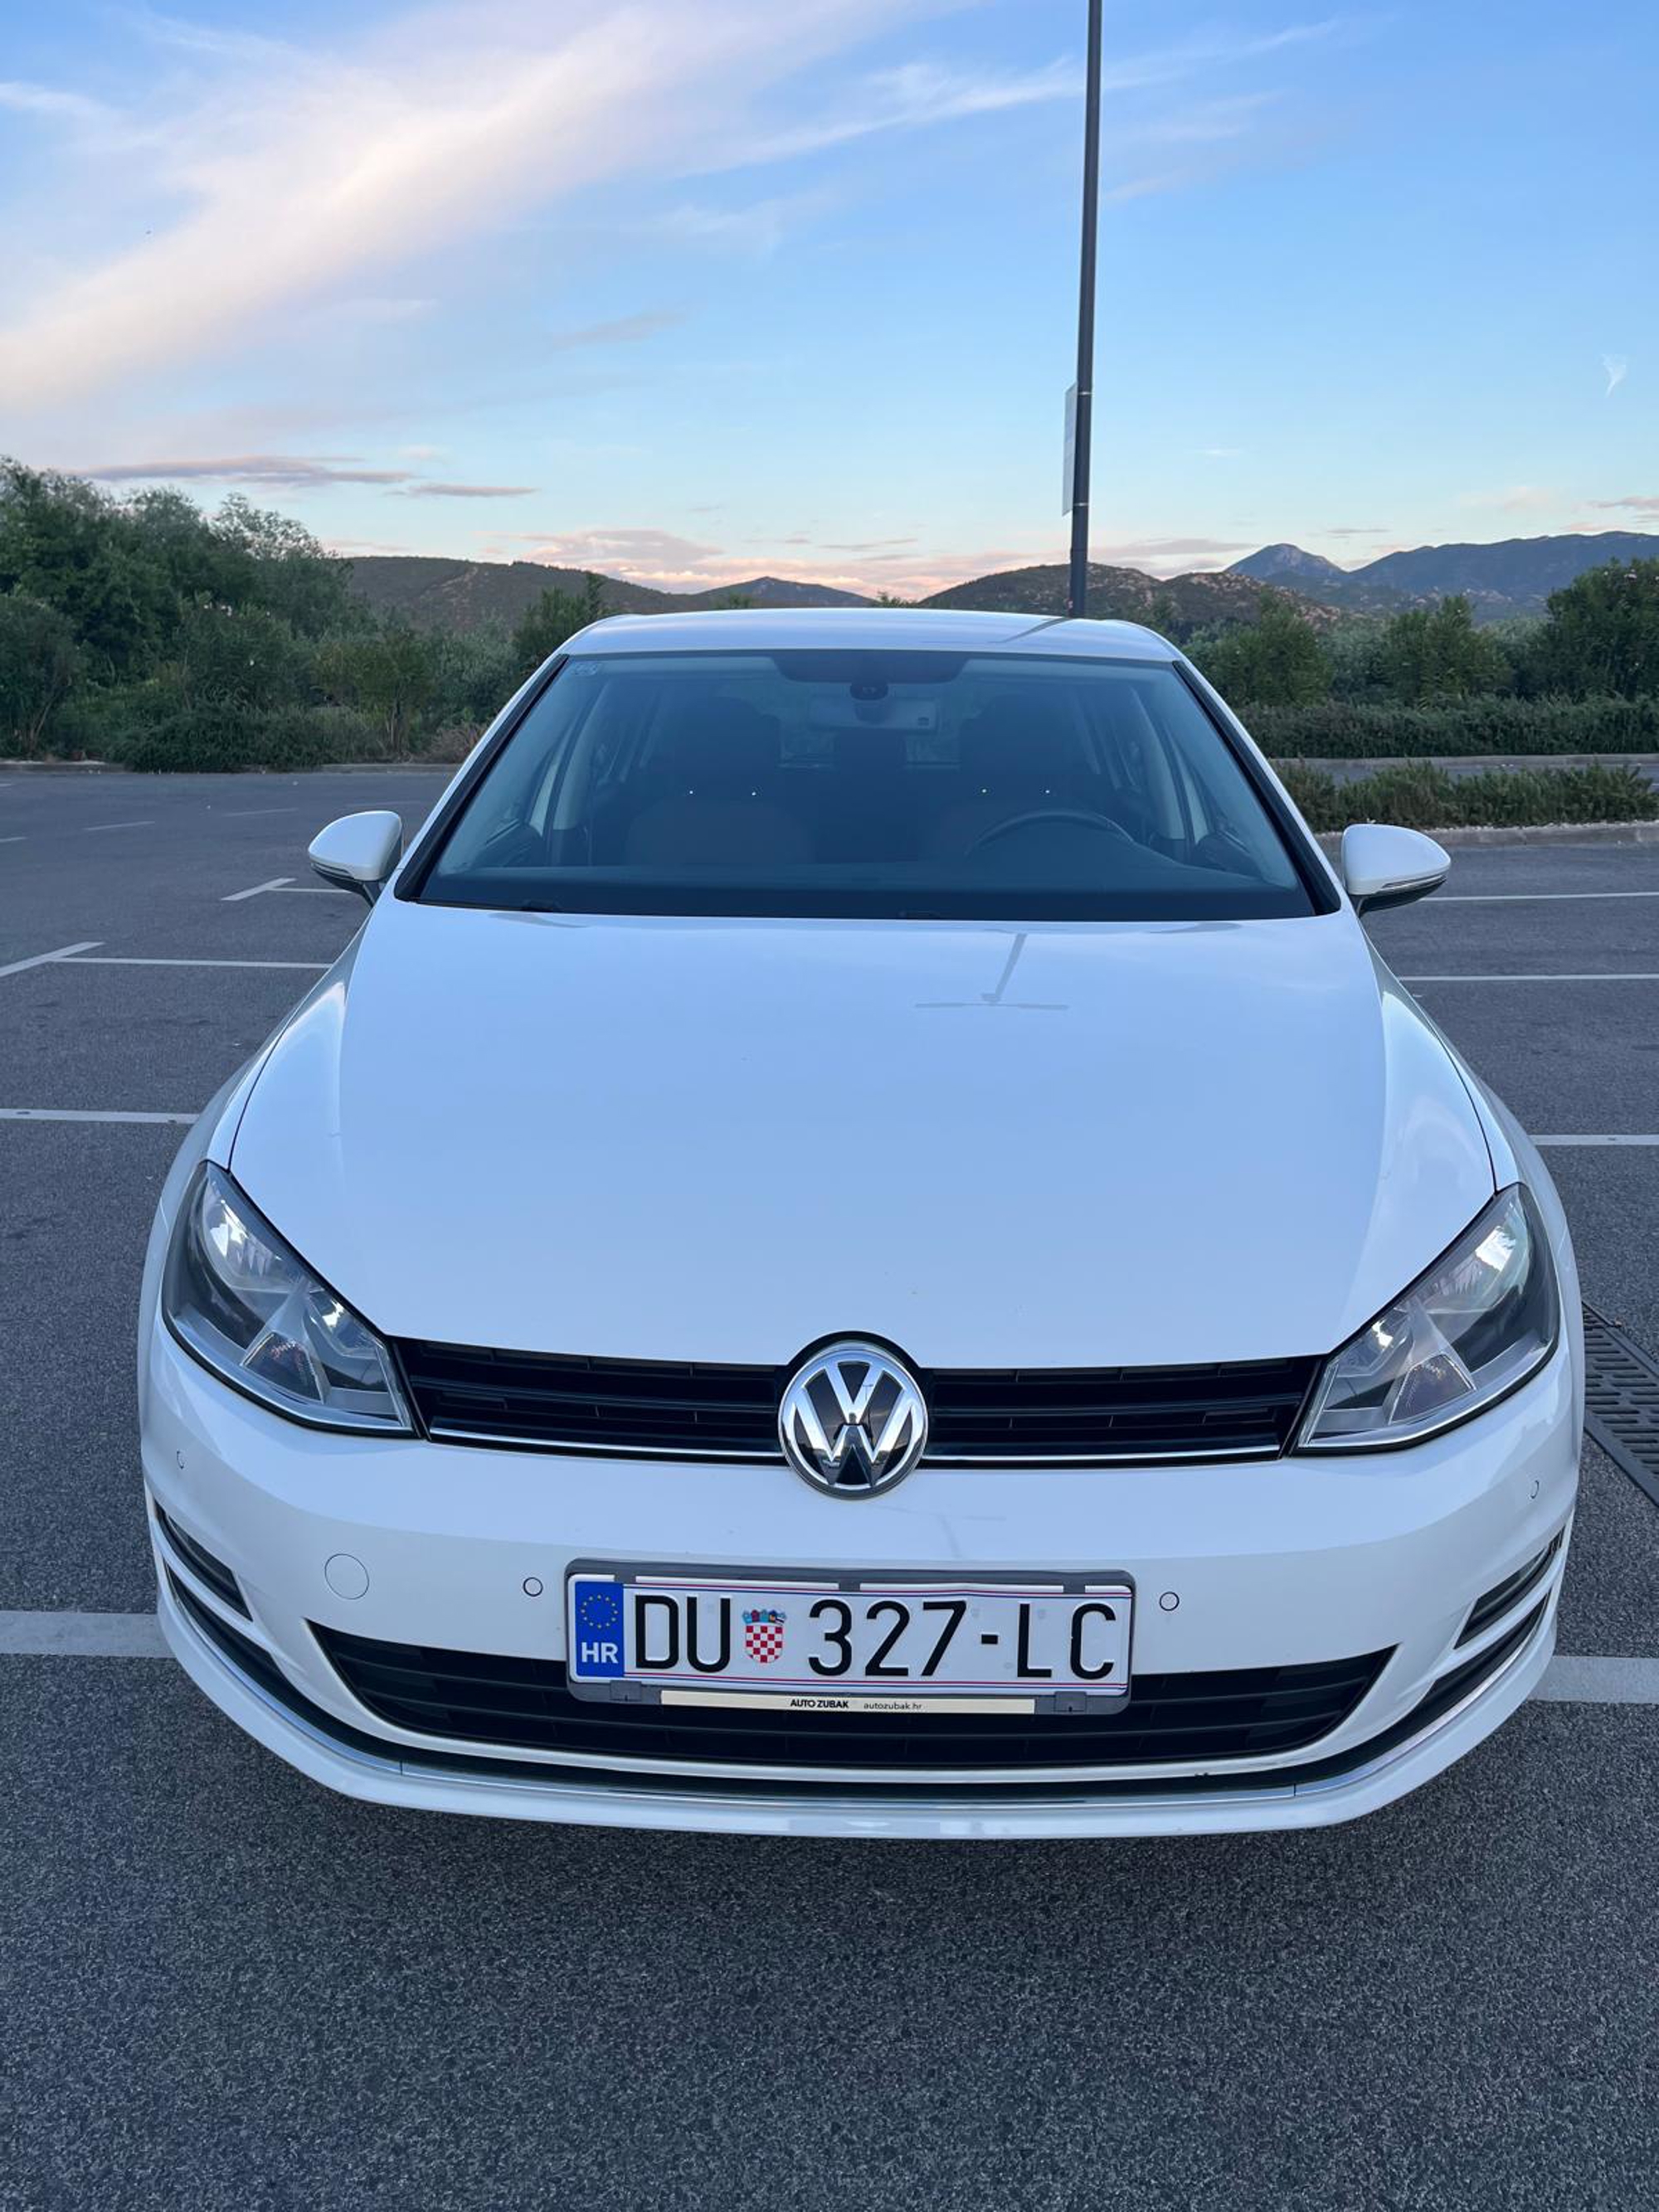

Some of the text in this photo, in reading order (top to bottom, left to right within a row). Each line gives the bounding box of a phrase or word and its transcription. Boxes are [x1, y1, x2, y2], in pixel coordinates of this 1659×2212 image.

[781, 1345, 925, 1495] VW
[635, 1594, 1117, 1680] DU 327-LC
[581, 1641, 619, 1664] HR
[790, 1699, 849, 1709] AUTO ZUBAK
[863, 1701, 922, 1710] autozubak.hr
